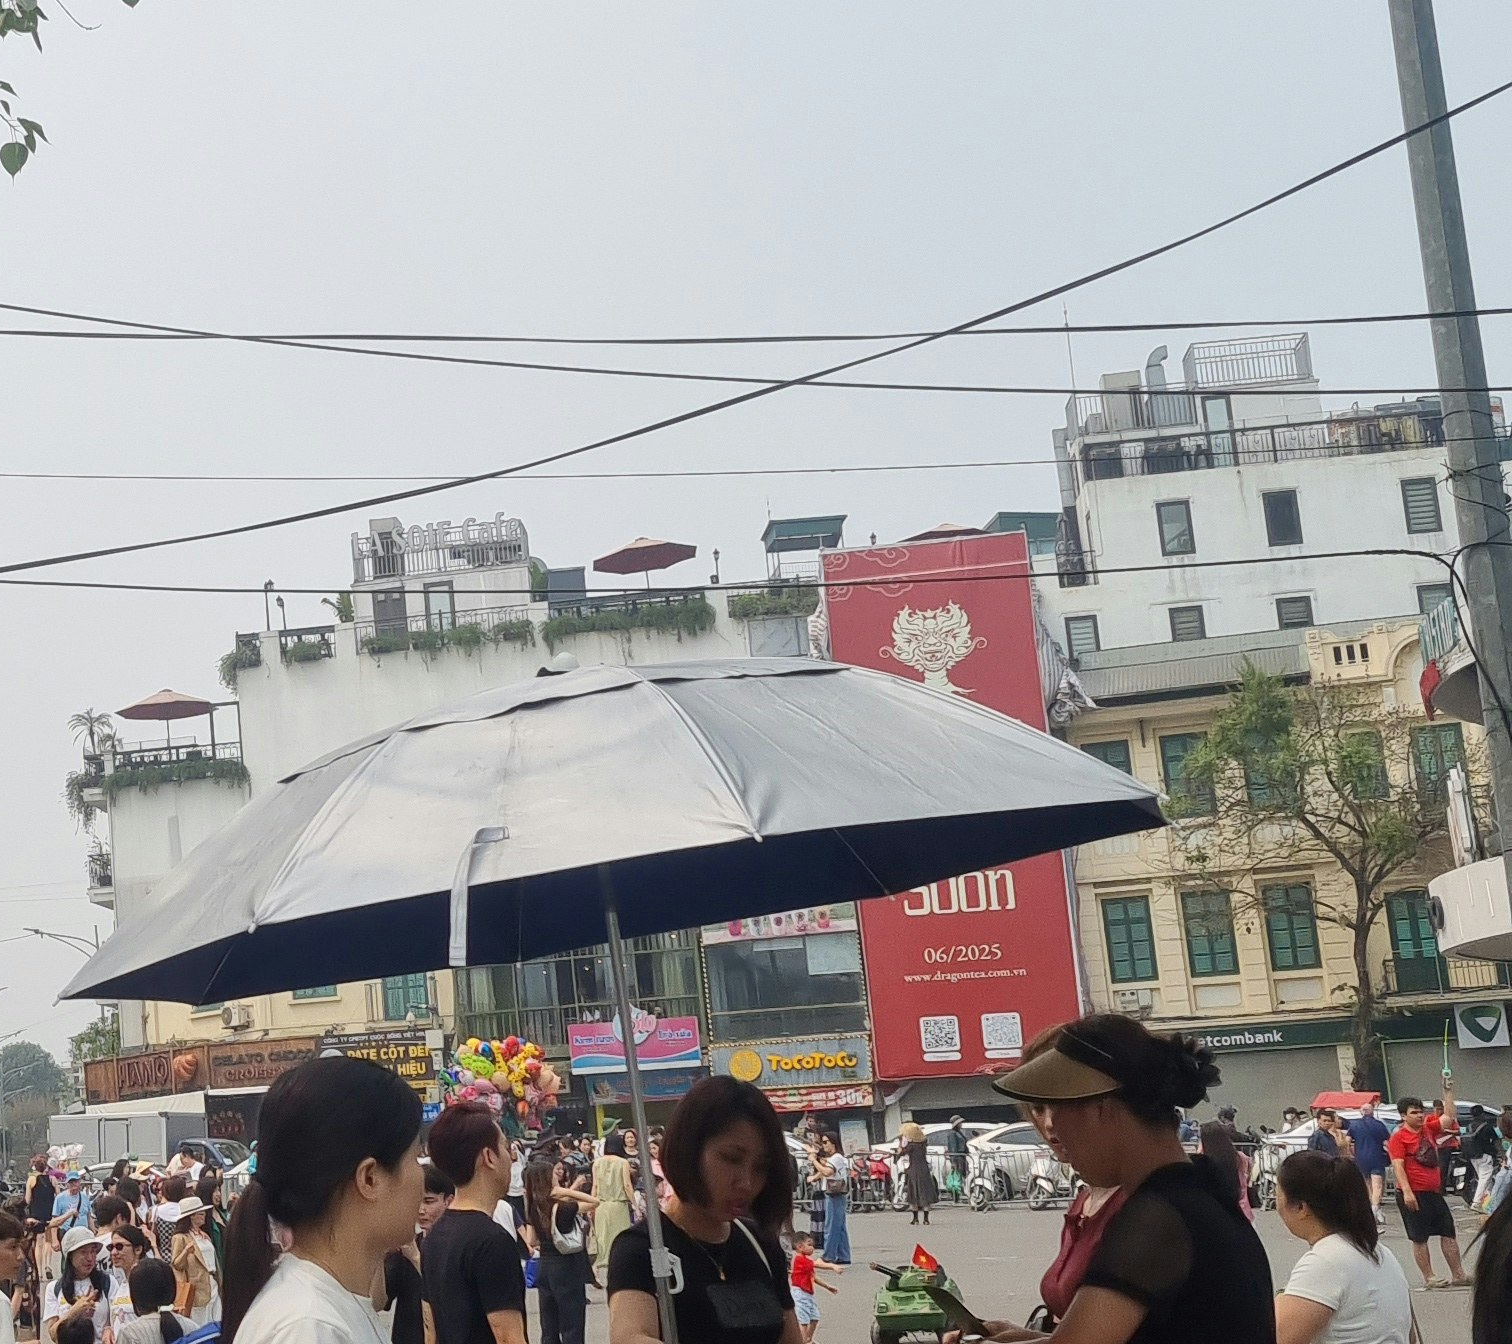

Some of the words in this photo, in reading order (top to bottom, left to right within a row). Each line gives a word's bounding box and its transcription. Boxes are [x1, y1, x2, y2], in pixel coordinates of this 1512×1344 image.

[350, 530, 384, 559] LA
[462, 511, 522, 547] Cafe
[923, 943, 1002, 964] 06/2025
[903, 967, 1027, 983] www.dragontea.com.vn
